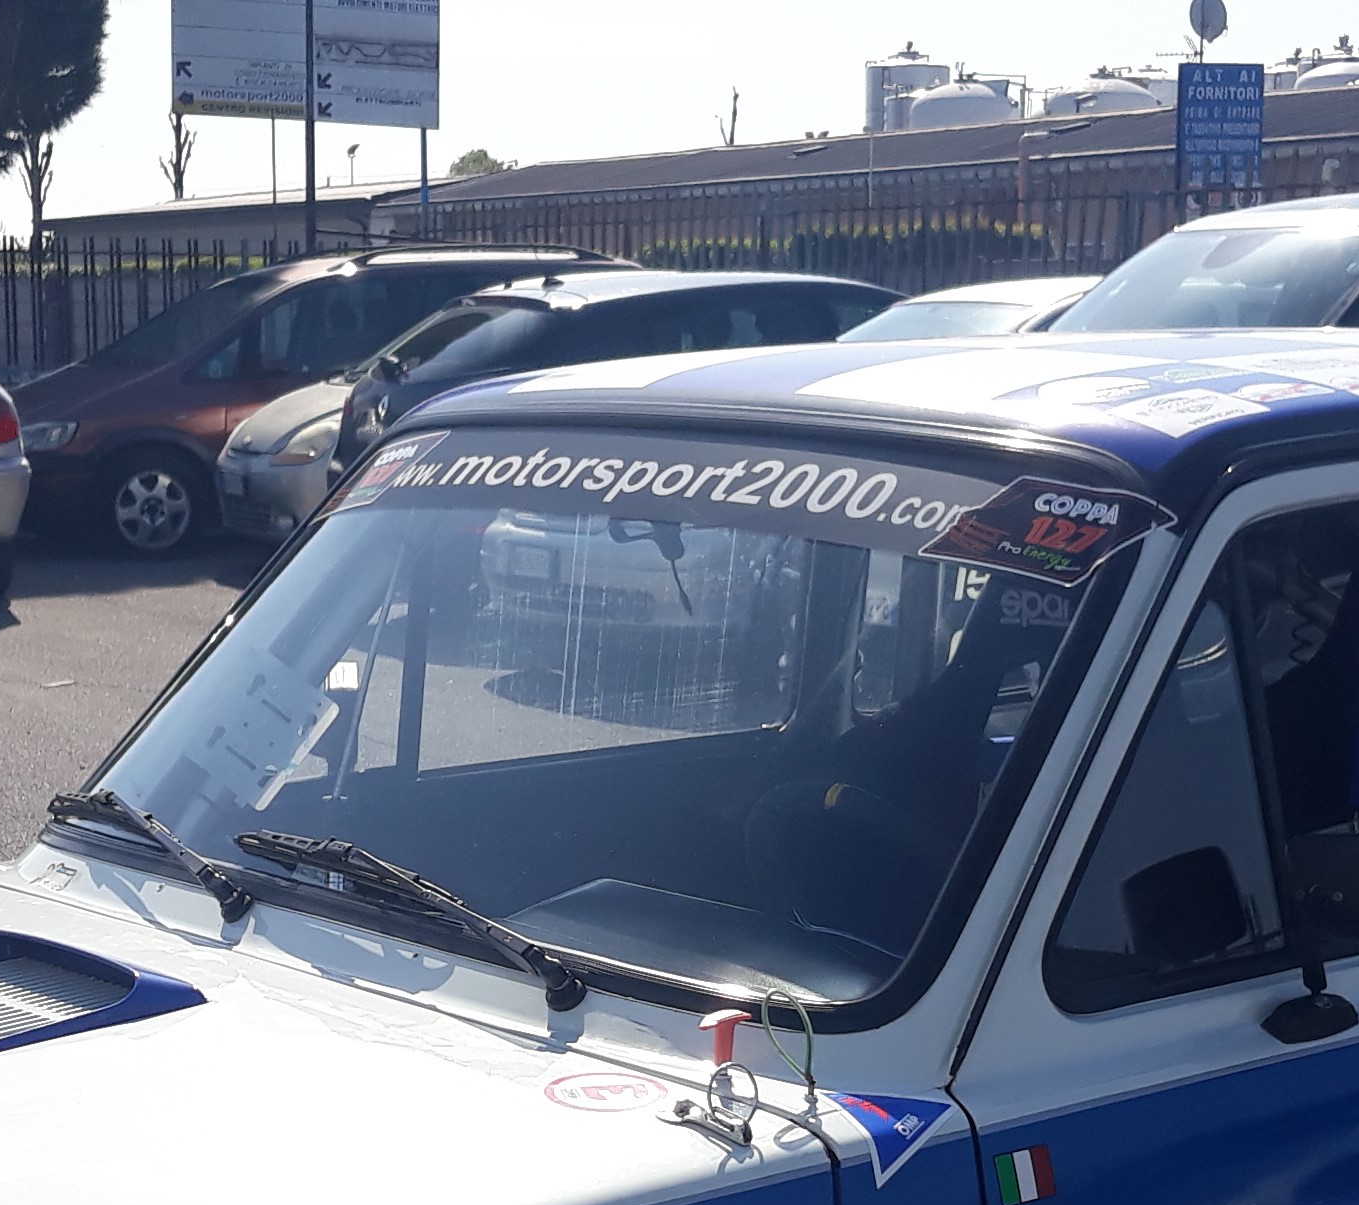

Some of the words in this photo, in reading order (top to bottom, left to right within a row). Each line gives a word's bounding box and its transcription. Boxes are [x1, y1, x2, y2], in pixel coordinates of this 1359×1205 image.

[1193, 69, 1223, 83] ALT
[1240, 69, 1256, 83] AI
[1188, 86, 1260, 100] FORNITORI
[1034, 492, 1120, 525] COPPA
[1024, 516, 1108, 553] 127
[897, 1115, 919, 1136] OMP
